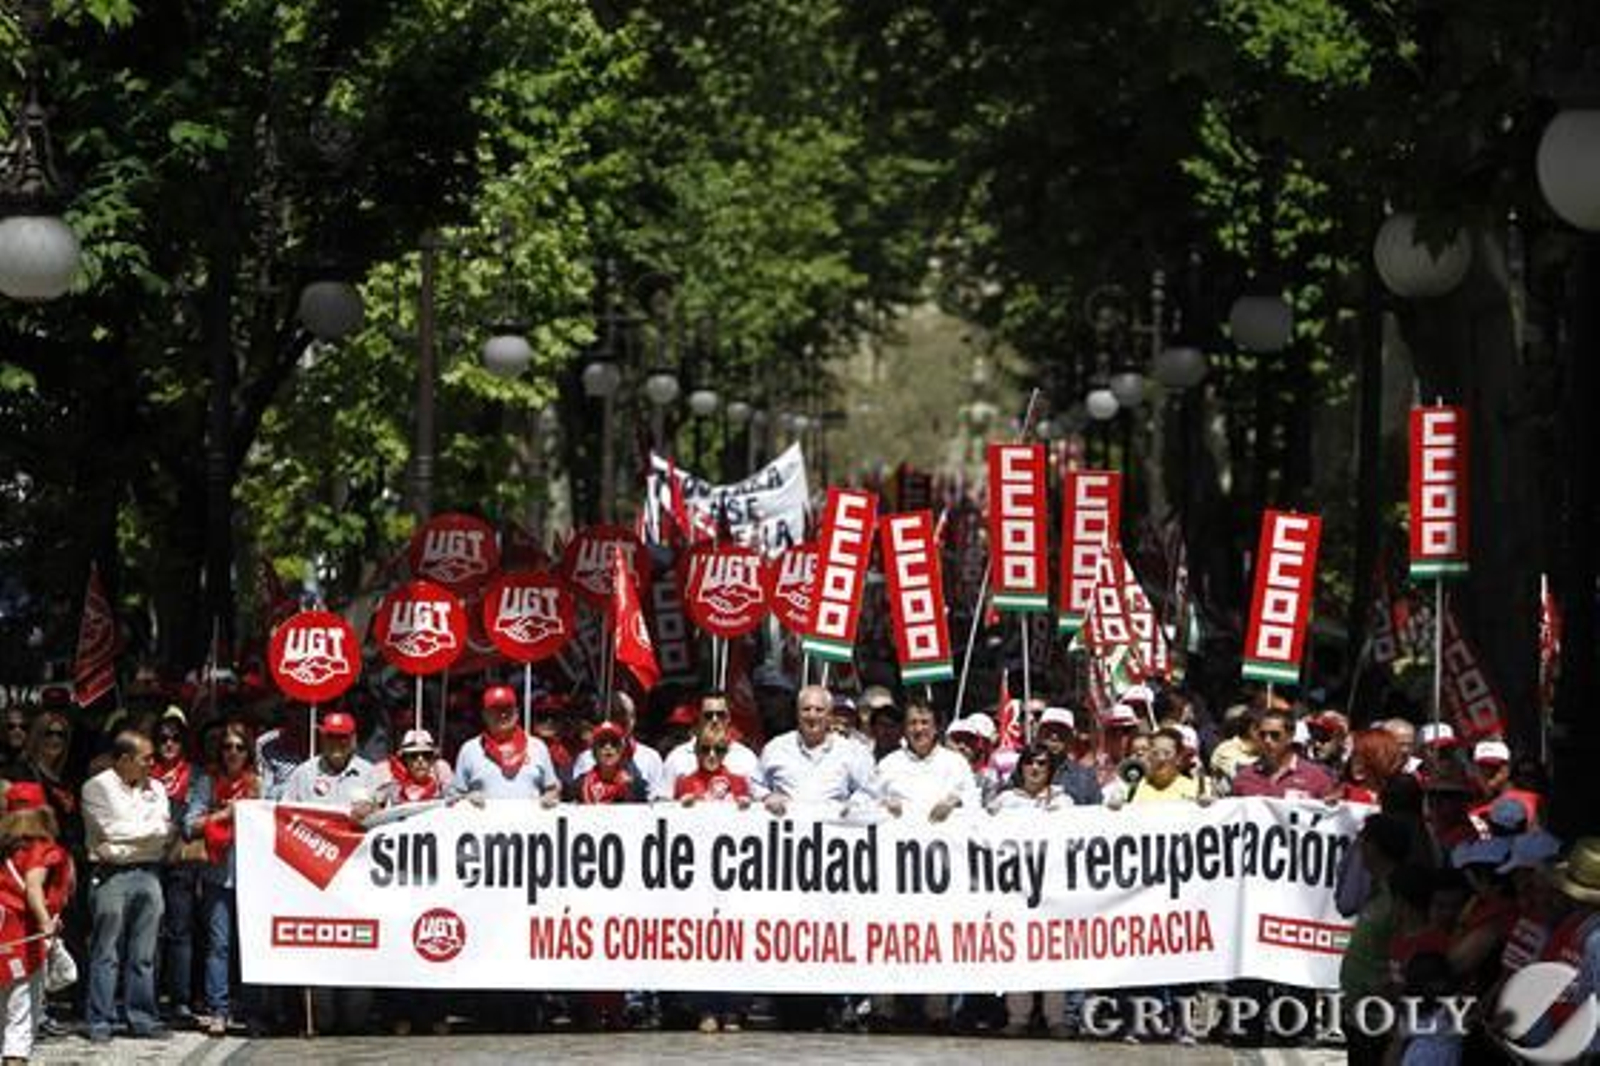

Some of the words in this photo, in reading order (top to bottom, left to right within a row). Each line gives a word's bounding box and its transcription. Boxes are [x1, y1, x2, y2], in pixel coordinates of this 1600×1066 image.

[1422, 411, 1457, 555] CCOO
[1001, 447, 1037, 588] CCOO
[422, 530, 485, 562] UGT
[701, 555, 762, 590] UGT
[778, 553, 819, 585] UG
[815, 493, 868, 638] CCOO
[500, 587, 559, 619] UGT
[890, 515, 940, 660] CCOO
[1256, 515, 1309, 661] CCOO
[389, 601, 450, 635] UGT
[284, 627, 345, 661] UGT
[370, 831, 438, 887] sin
[456, 816, 625, 905] empleo
[641, 818, 695, 891] de
[711, 819, 879, 893] calidad
[895, 838, 951, 895] no
[1065, 811, 1349, 900] recuperación
[278, 922, 352, 942] CCOO
[419, 917, 458, 938] UGT
[529, 906, 594, 961] MÁS
[603, 907, 744, 962] COHESIÓN
[755, 919, 857, 963] SOCIAL
[866, 922, 942, 964] PARA
[952, 911, 1016, 964] MÁS
[1027, 909, 1215, 962] DEMOCRACIA
[1263, 919, 1332, 947] CCOO
